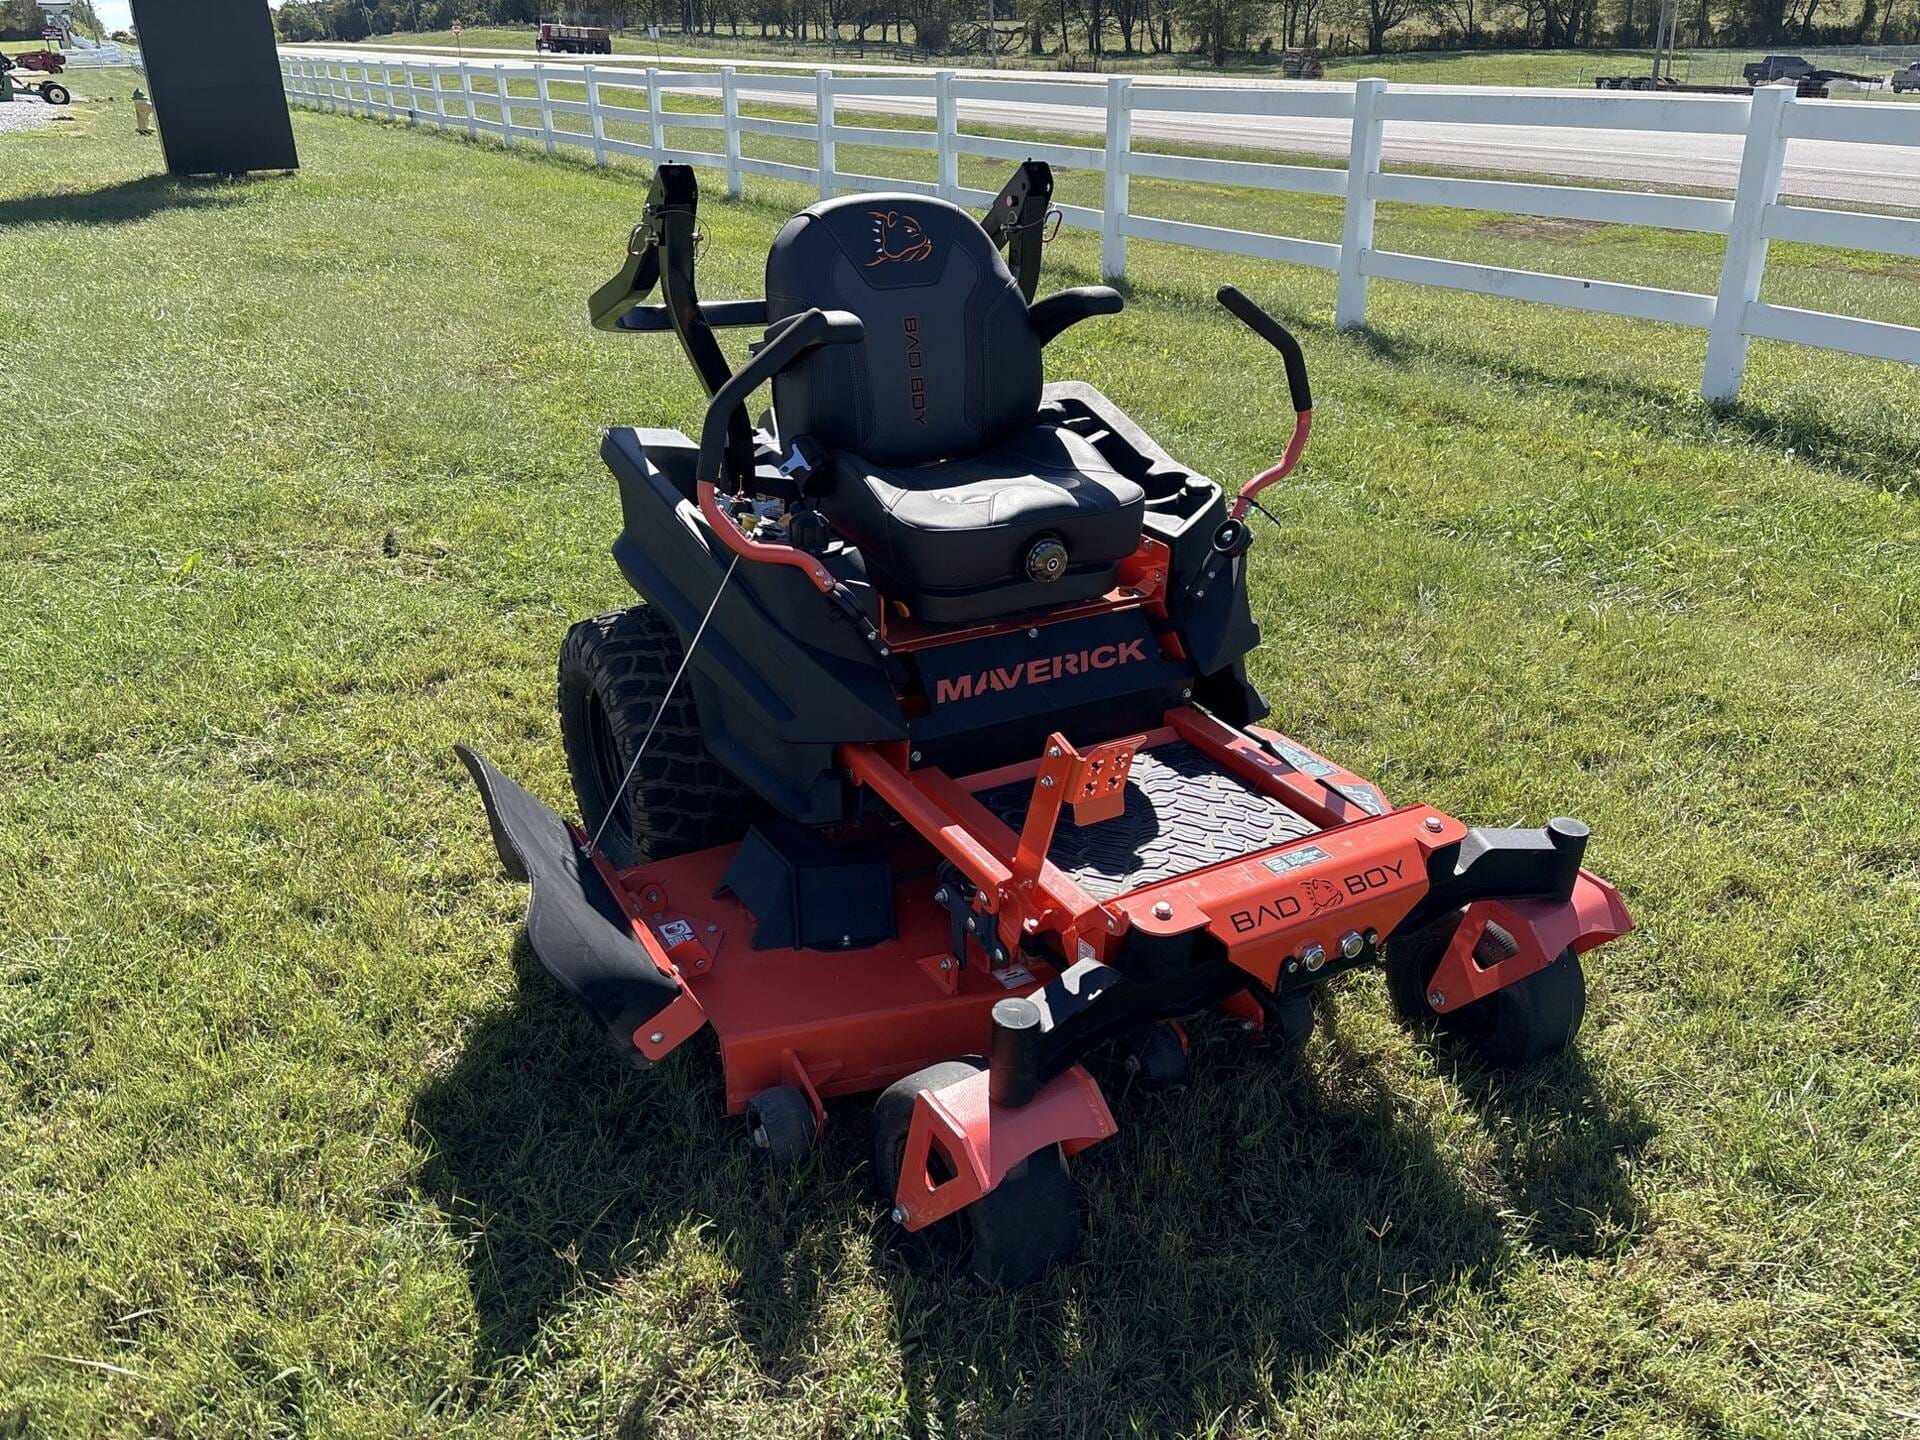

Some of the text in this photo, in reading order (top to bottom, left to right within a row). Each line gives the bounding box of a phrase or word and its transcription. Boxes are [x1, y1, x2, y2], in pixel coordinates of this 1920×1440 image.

[904, 317, 927, 426] BAD BOY
[937, 638, 1147, 703] MAVERICK
[1230, 859, 1403, 933] BAD BOY
